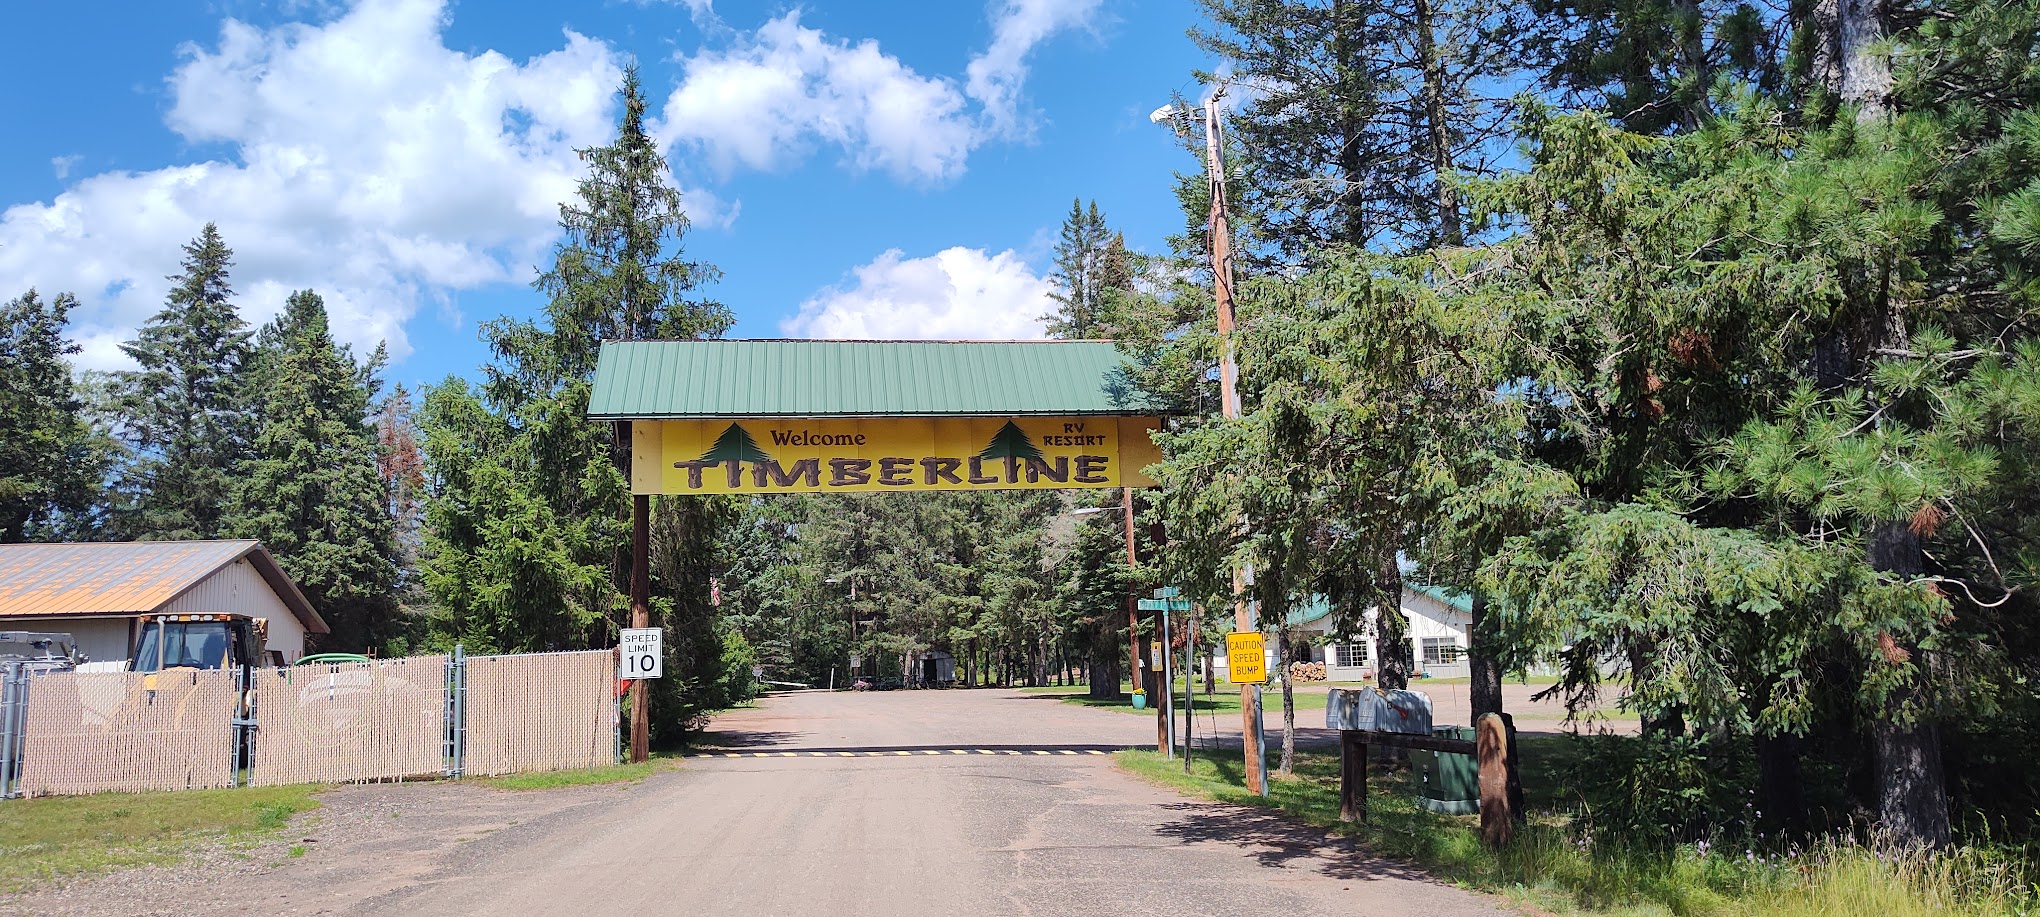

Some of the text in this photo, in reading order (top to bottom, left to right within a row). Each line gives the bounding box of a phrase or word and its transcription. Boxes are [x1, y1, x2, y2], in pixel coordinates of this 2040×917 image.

[1063, 423, 1085, 433] RV
[770, 430, 866, 446] Welcome
[1043, 435, 1106, 446] RESORT
[673, 455, 1110, 489] TIMBERLINE
[625, 635, 658, 643] SPEED
[1230, 640, 1262, 651] CAUTION
[629, 655, 655, 672] 10
[1234, 653, 1260, 663] SPEED
[1236, 665, 1259, 675] BUMP
